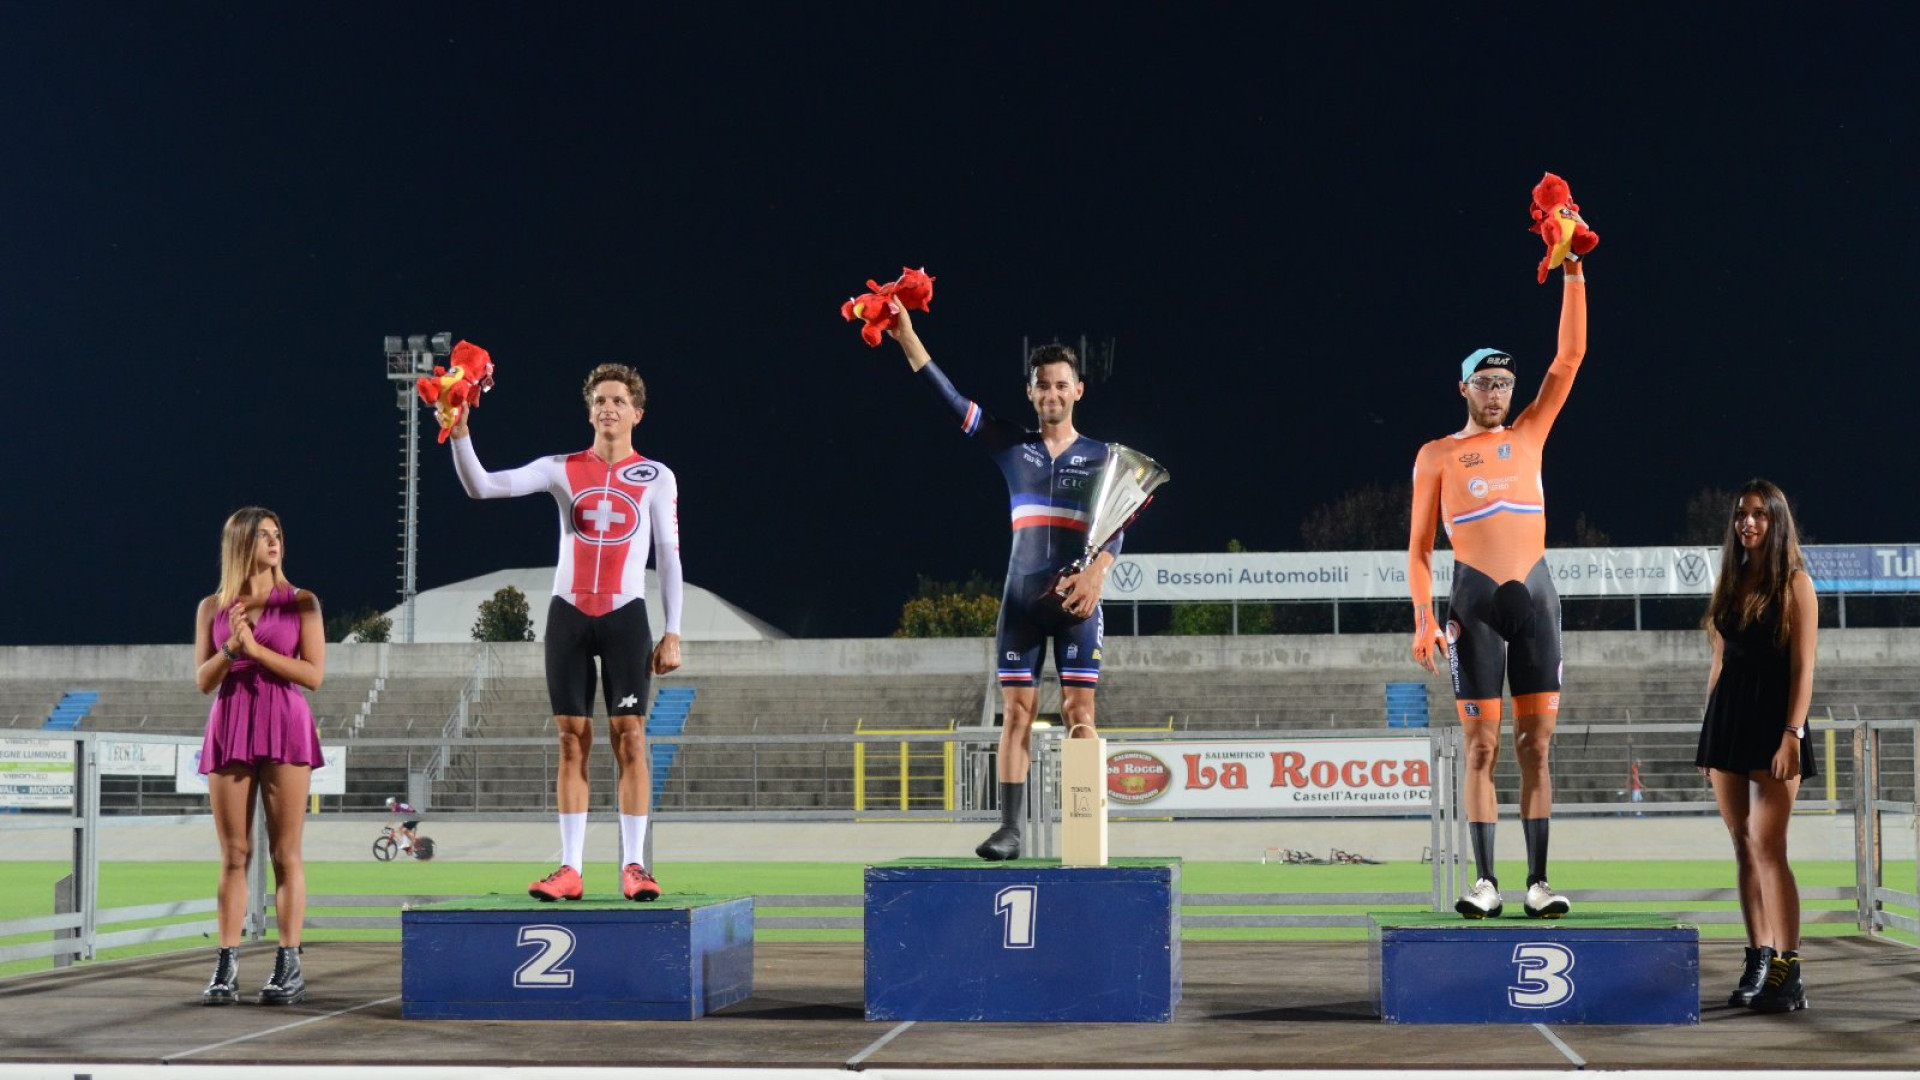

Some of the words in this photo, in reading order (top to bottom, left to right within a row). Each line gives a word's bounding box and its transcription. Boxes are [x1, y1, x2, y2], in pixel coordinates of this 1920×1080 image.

[1487, 357, 1511, 365] BEAT
[1157, 568, 1233, 585] Bossoni
[1239, 566, 1349, 584] Automobili
[1378, 566, 1405, 582] Via
[1588, 564, 1666, 579] Piacenza
[24, 750, 67, 759] LUMINOSE
[1206, 751, 1265, 759] SALUMIFICIO
[1125, 763, 1164, 774] Rocca
[1183, 753, 1248, 790] La
[1270, 751, 1431, 788] Rocca
[29, 786, 73, 794] MONITOR
[1293, 791, 1400, 802] Castell'Arquato
[995, 885, 1037, 949] 1
[513, 924, 577, 988] 2
[1508, 942, 1575, 1009] 3
